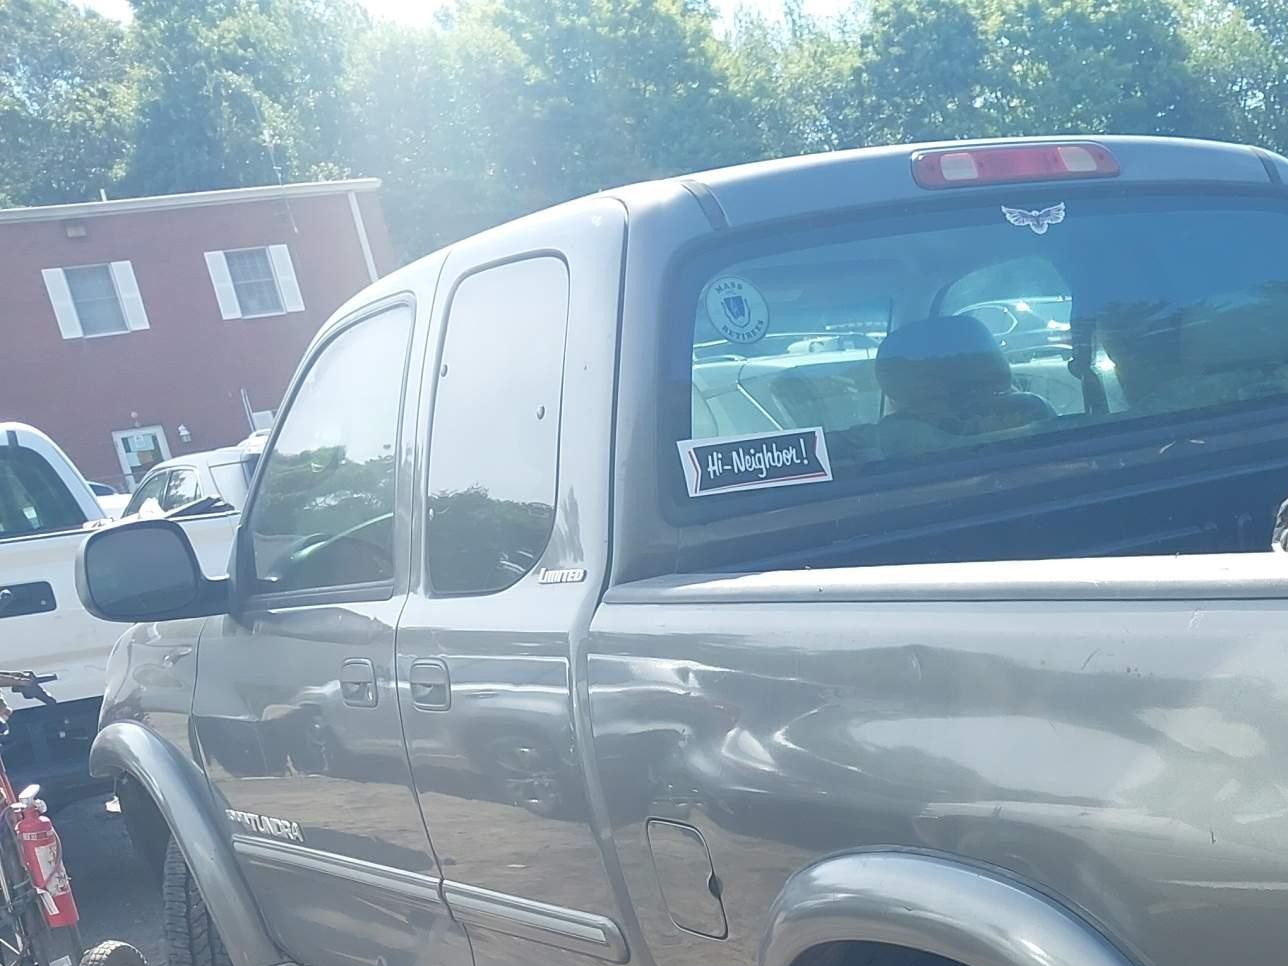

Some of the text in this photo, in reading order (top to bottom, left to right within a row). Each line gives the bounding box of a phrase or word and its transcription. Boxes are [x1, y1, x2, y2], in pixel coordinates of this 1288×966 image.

[714, 281, 743, 295] MASS
[721, 319, 764, 341] RETIREES
[246, 812, 304, 843] TUNDRA
